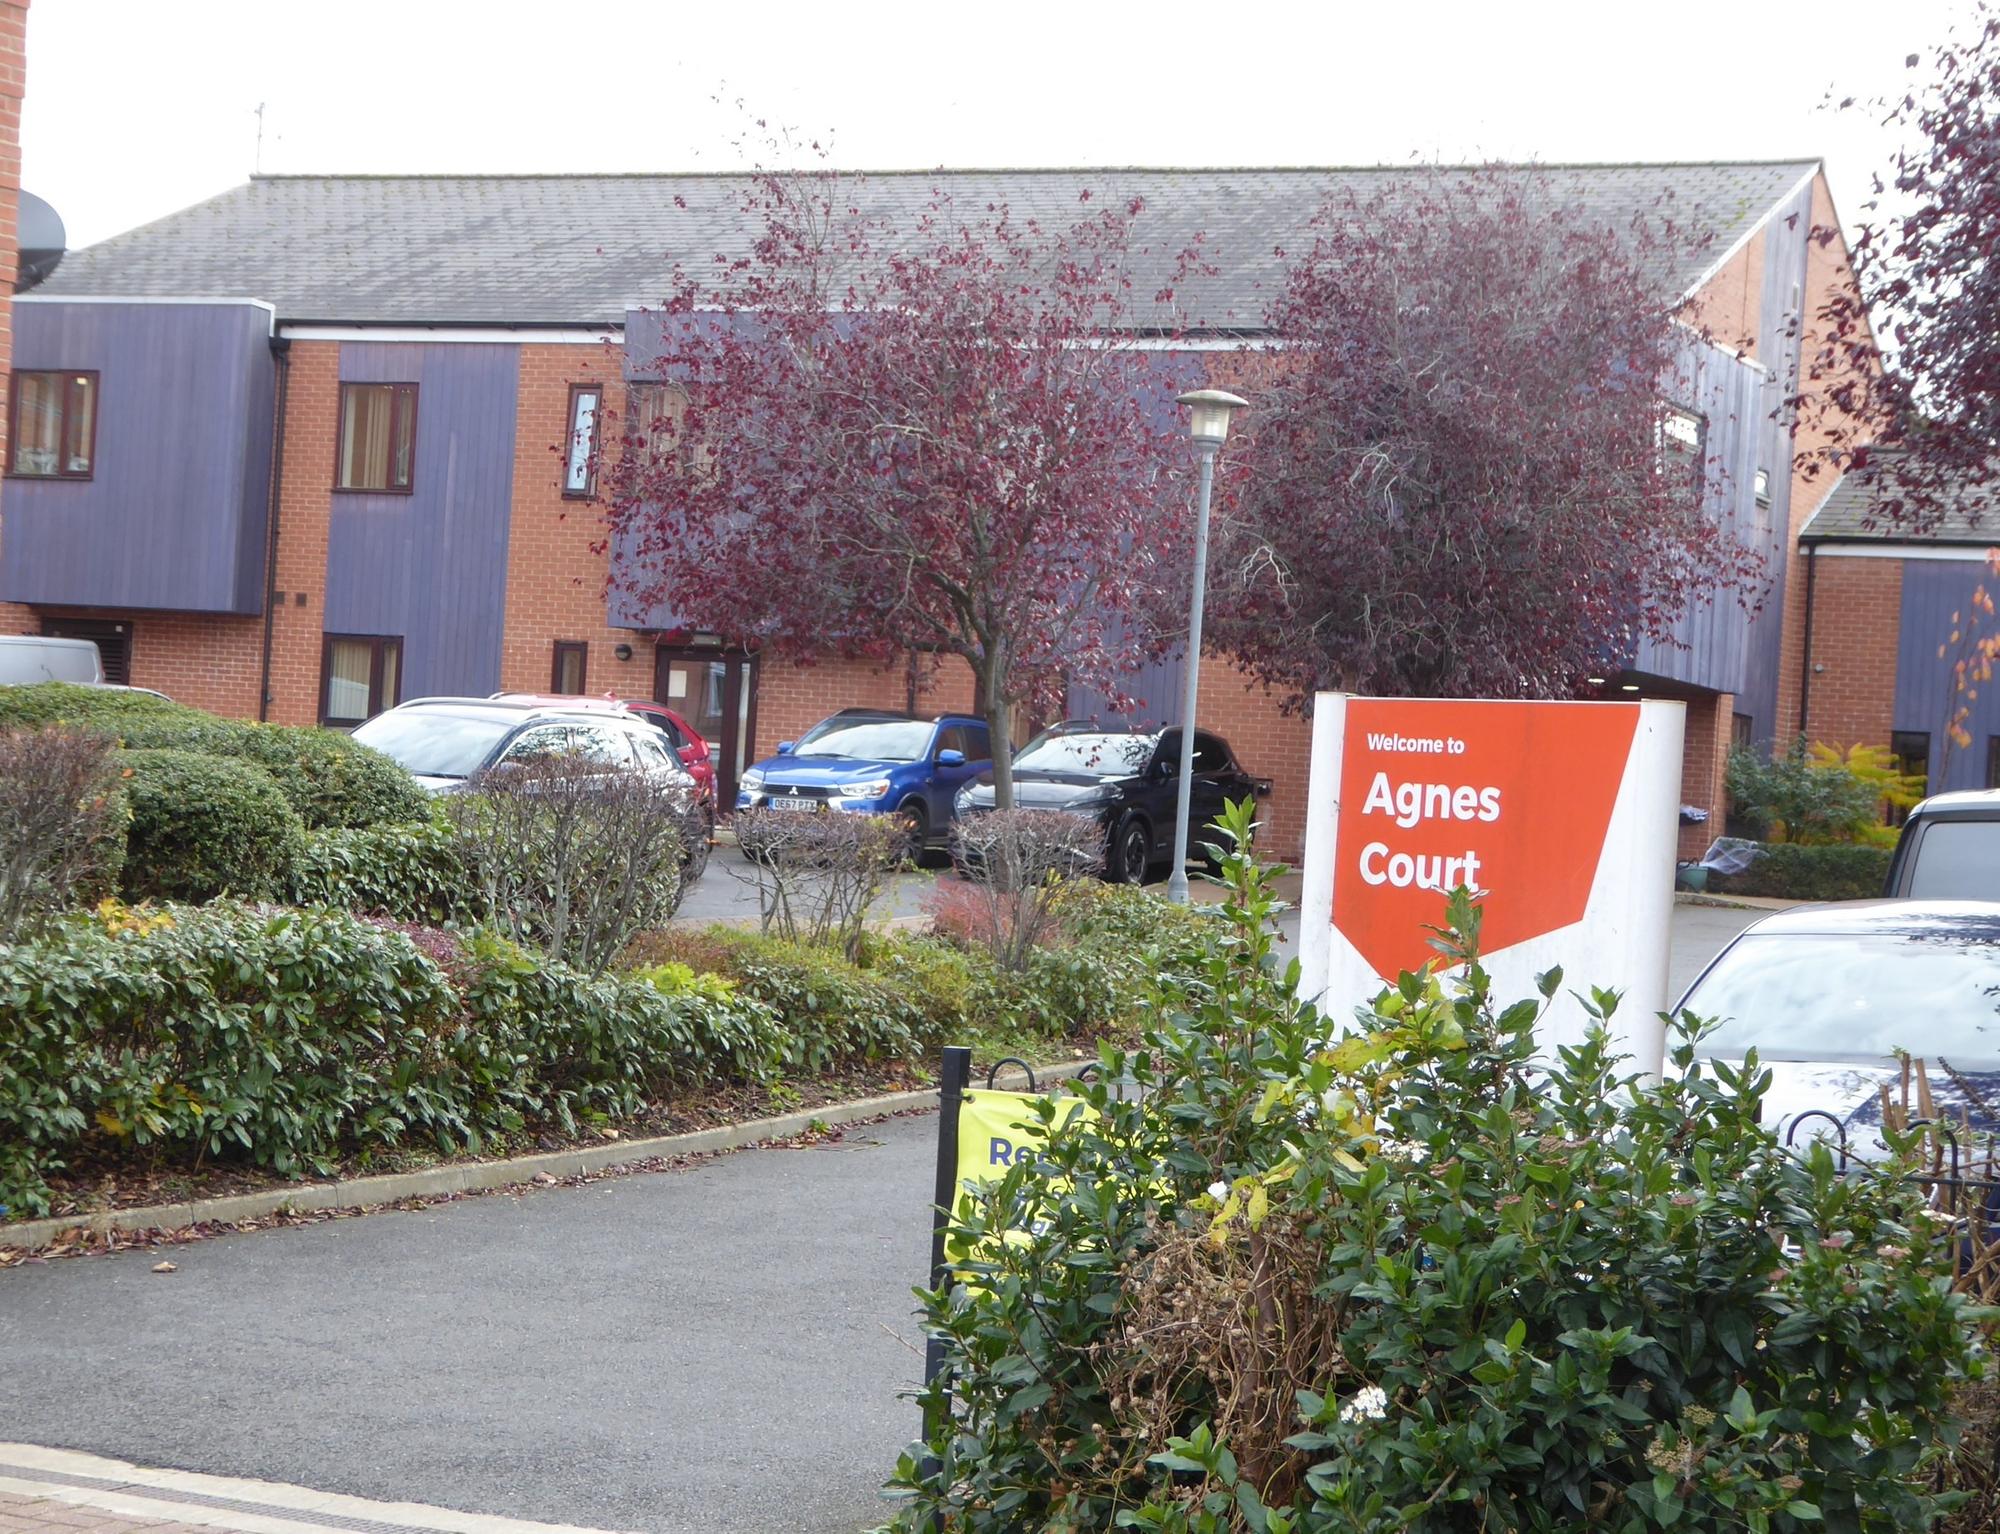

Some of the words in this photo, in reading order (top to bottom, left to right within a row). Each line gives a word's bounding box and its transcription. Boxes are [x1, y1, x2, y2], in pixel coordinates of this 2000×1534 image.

[1367, 733, 1443, 752] Welcome
[1447, 736, 1465, 754] to
[1361, 771, 1501, 828] Agnes
[1359, 841, 1481, 893] Court
